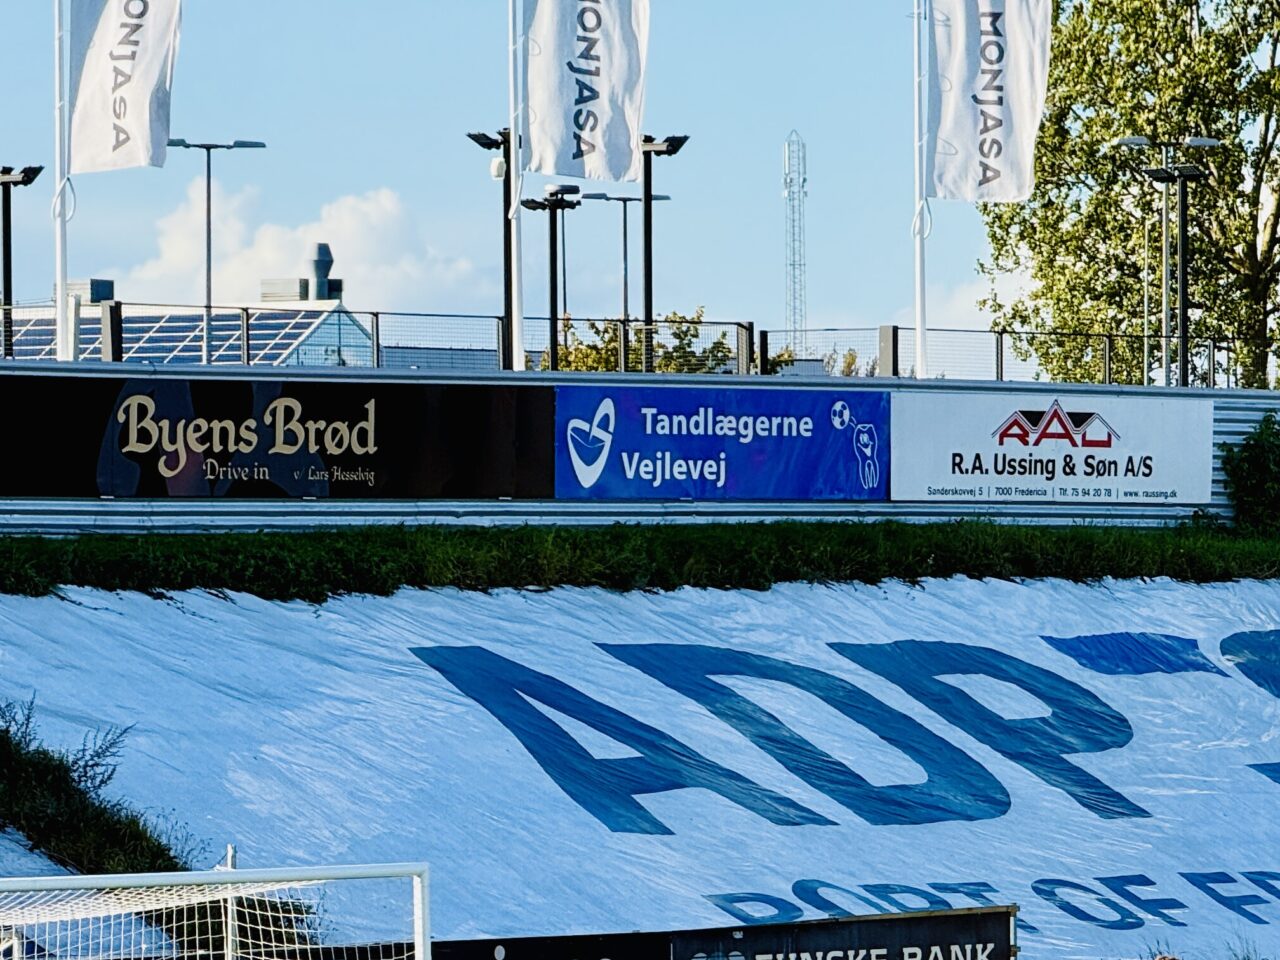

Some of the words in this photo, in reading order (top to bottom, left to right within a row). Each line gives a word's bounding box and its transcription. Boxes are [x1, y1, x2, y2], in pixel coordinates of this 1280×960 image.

[566, 0, 602, 160] ONJASA
[971, 12, 1005, 187] MONJASA
[117, 395, 258, 477] Byens
[264, 397, 378, 455] Brød
[641, 407, 813, 444] Tandlægerne
[203, 458, 249, 480] Drive
[253, 460, 269, 479] in
[308, 465, 329, 480] Lars
[331, 466, 375, 486] Hesselvig
[621, 452, 726, 488] Vejlevej
[951, 453, 989, 475] R.A.
[993, 453, 1056, 481] Ussing
[1062, 455, 1077, 476] &
[1083, 455, 1118, 478] Søn
[1124, 456, 1153, 477] A/S
[979, 487, 983, 496] 5
[995, 487, 1012, 496] 7000
[1015, 487, 1047, 496] Fredericia
[1071, 488, 1079, 496] 75
[1082, 488, 1090, 497] 94
[1093, 488, 1101, 497] 20
[1104, 488, 1112, 497] 78
[407, 640, 1153, 835] ADP
[1031, 874, 1189, 930] OF
